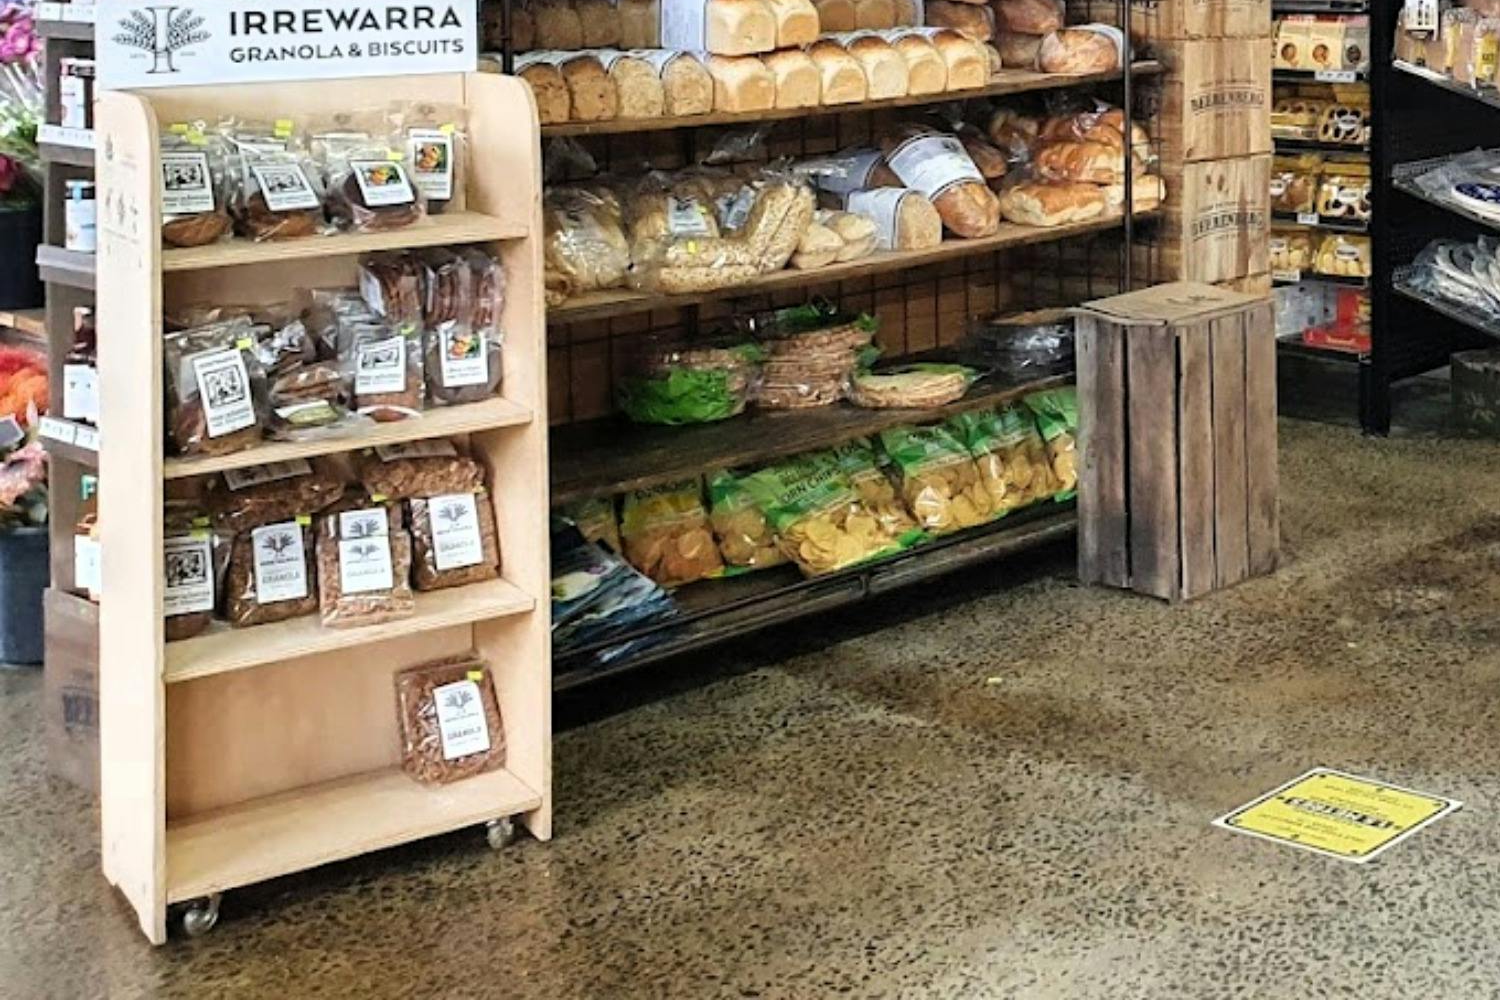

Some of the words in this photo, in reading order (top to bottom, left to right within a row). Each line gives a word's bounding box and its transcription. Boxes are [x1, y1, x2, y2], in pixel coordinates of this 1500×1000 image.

[229, 4, 463, 37] IRREWARRA
[229, 43, 343, 64] GRANOLA
[348, 41, 362, 58] &
[368, 38, 465, 57] BISCUITS
